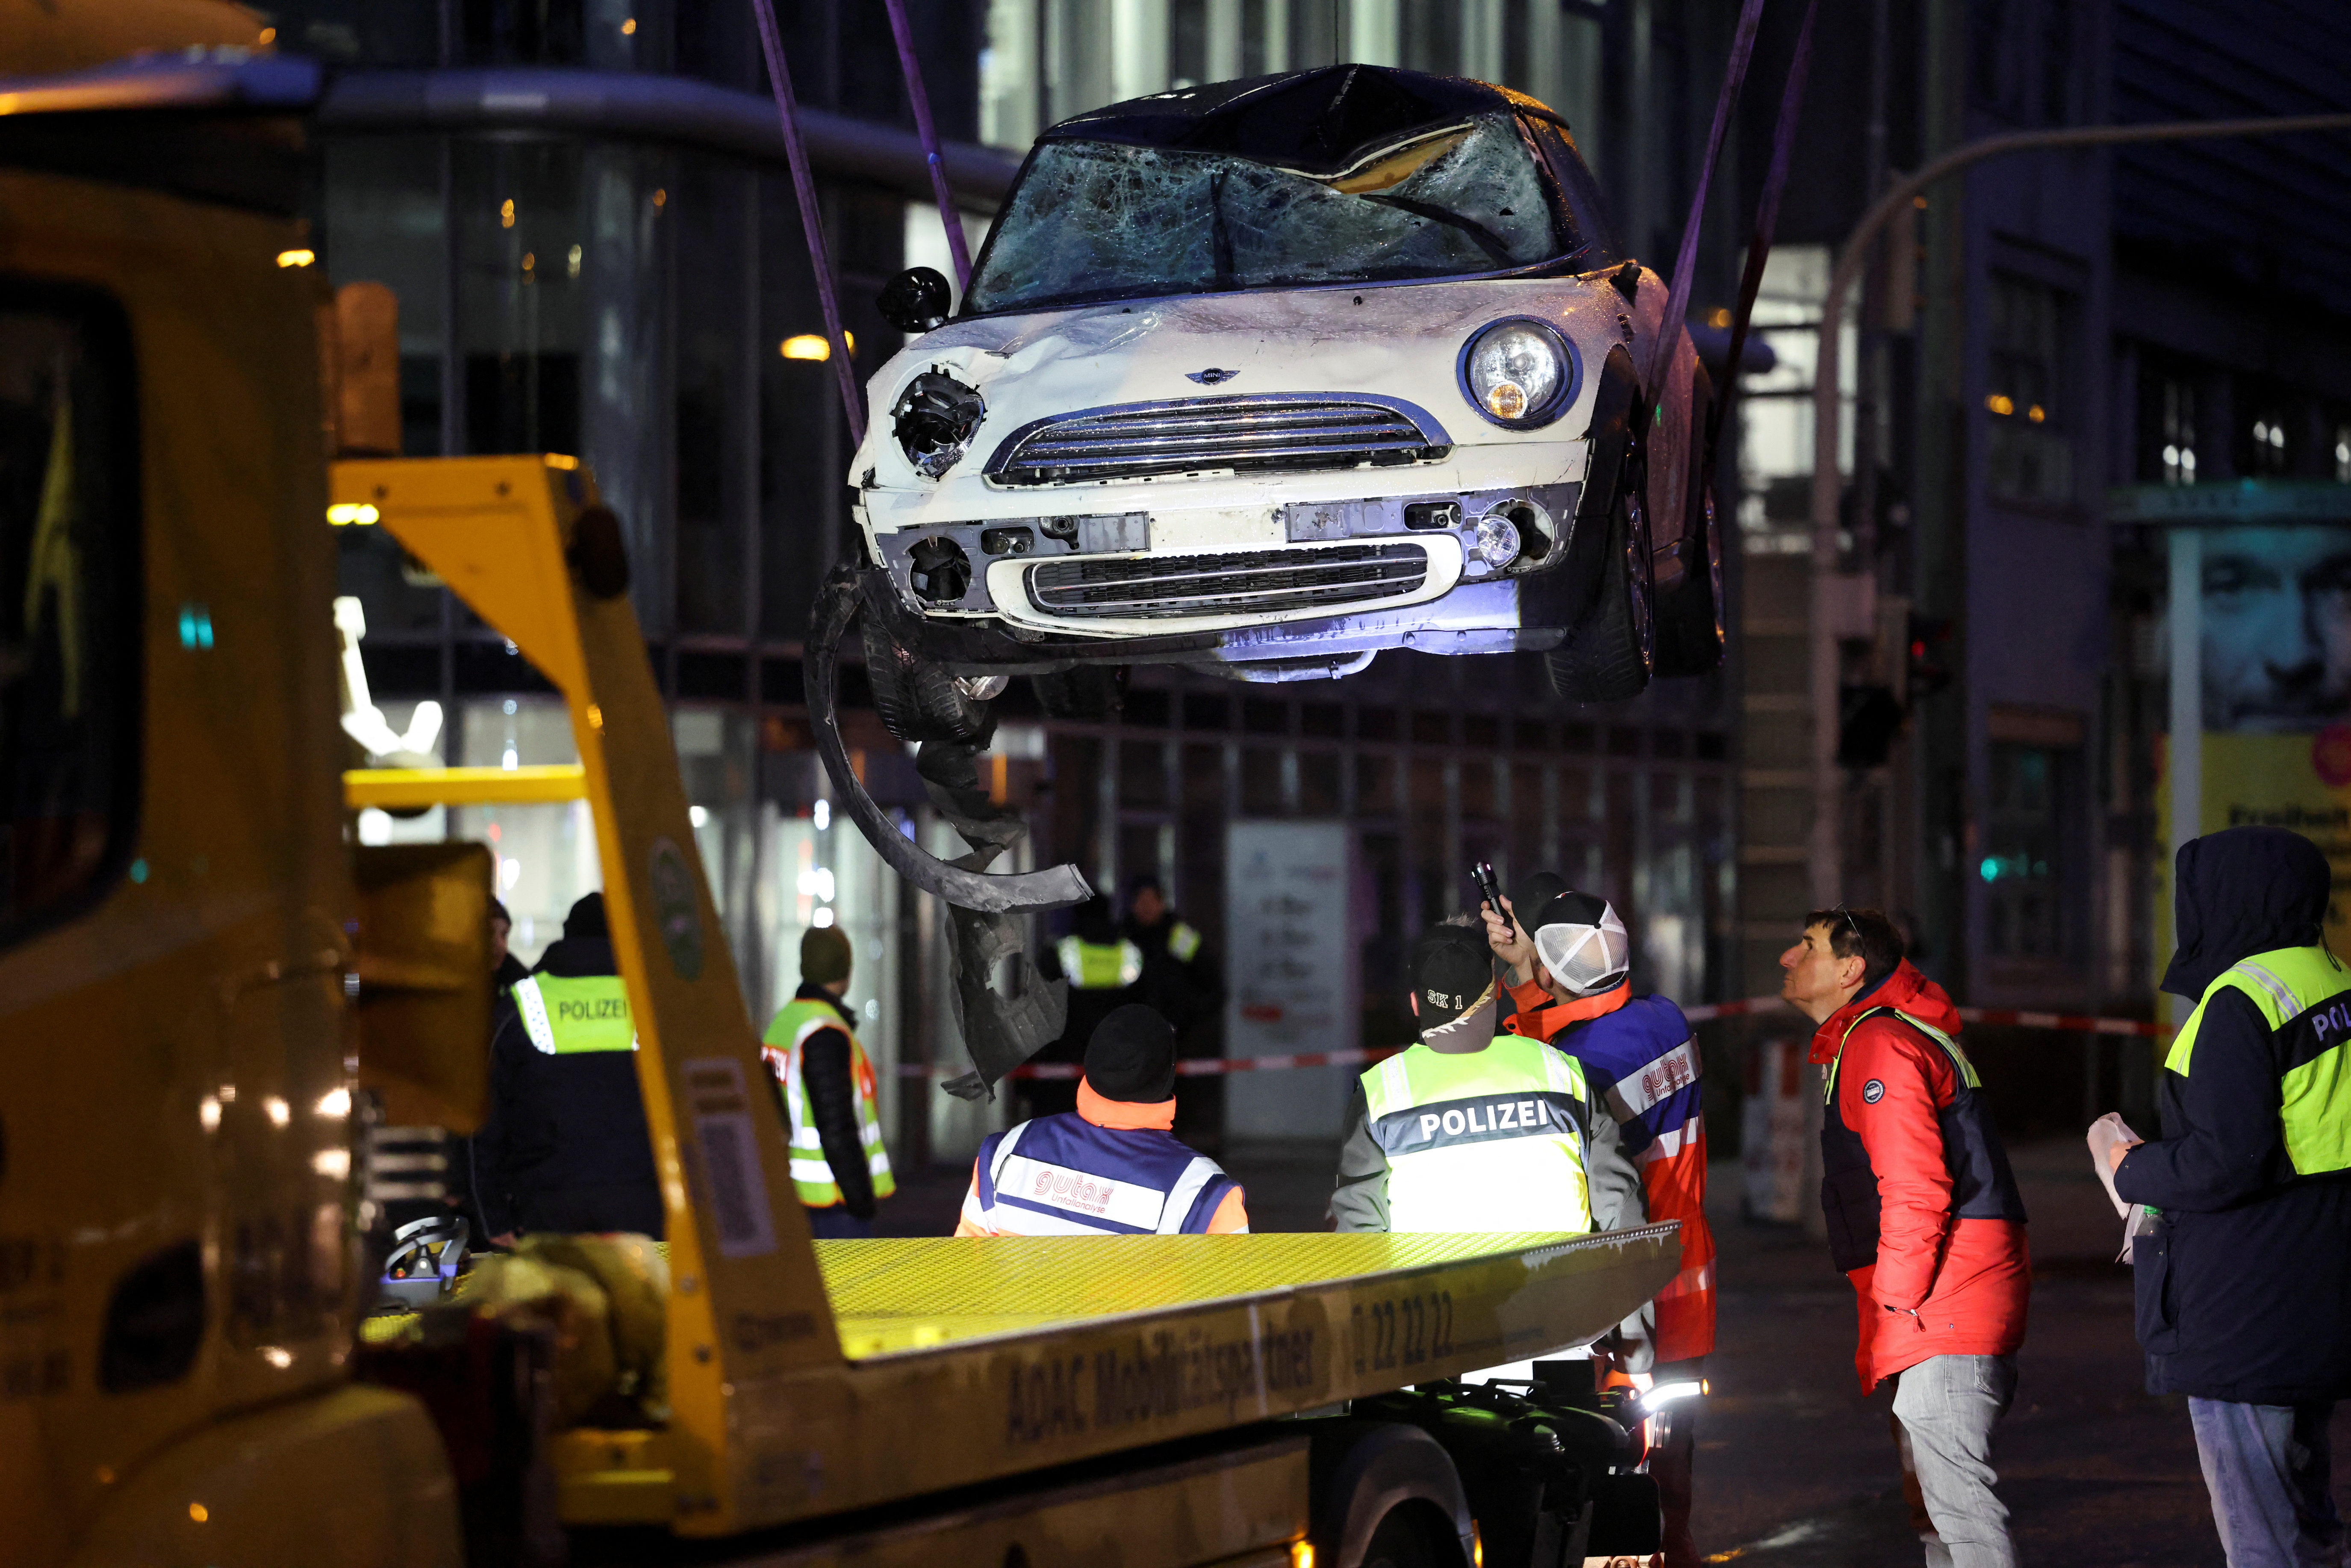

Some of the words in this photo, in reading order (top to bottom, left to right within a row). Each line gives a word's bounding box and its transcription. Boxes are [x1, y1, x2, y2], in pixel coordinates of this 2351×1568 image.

[1427, 989, 1449, 1009] SK
[1455, 995, 1463, 1010] 1
[1642, 1052, 1689, 1101] gutax
[1420, 1099, 1547, 1141] POLIZEI
[1034, 1171, 1114, 1205] gutax
[1052, 1193, 1106, 1214] Unfallanalyse
